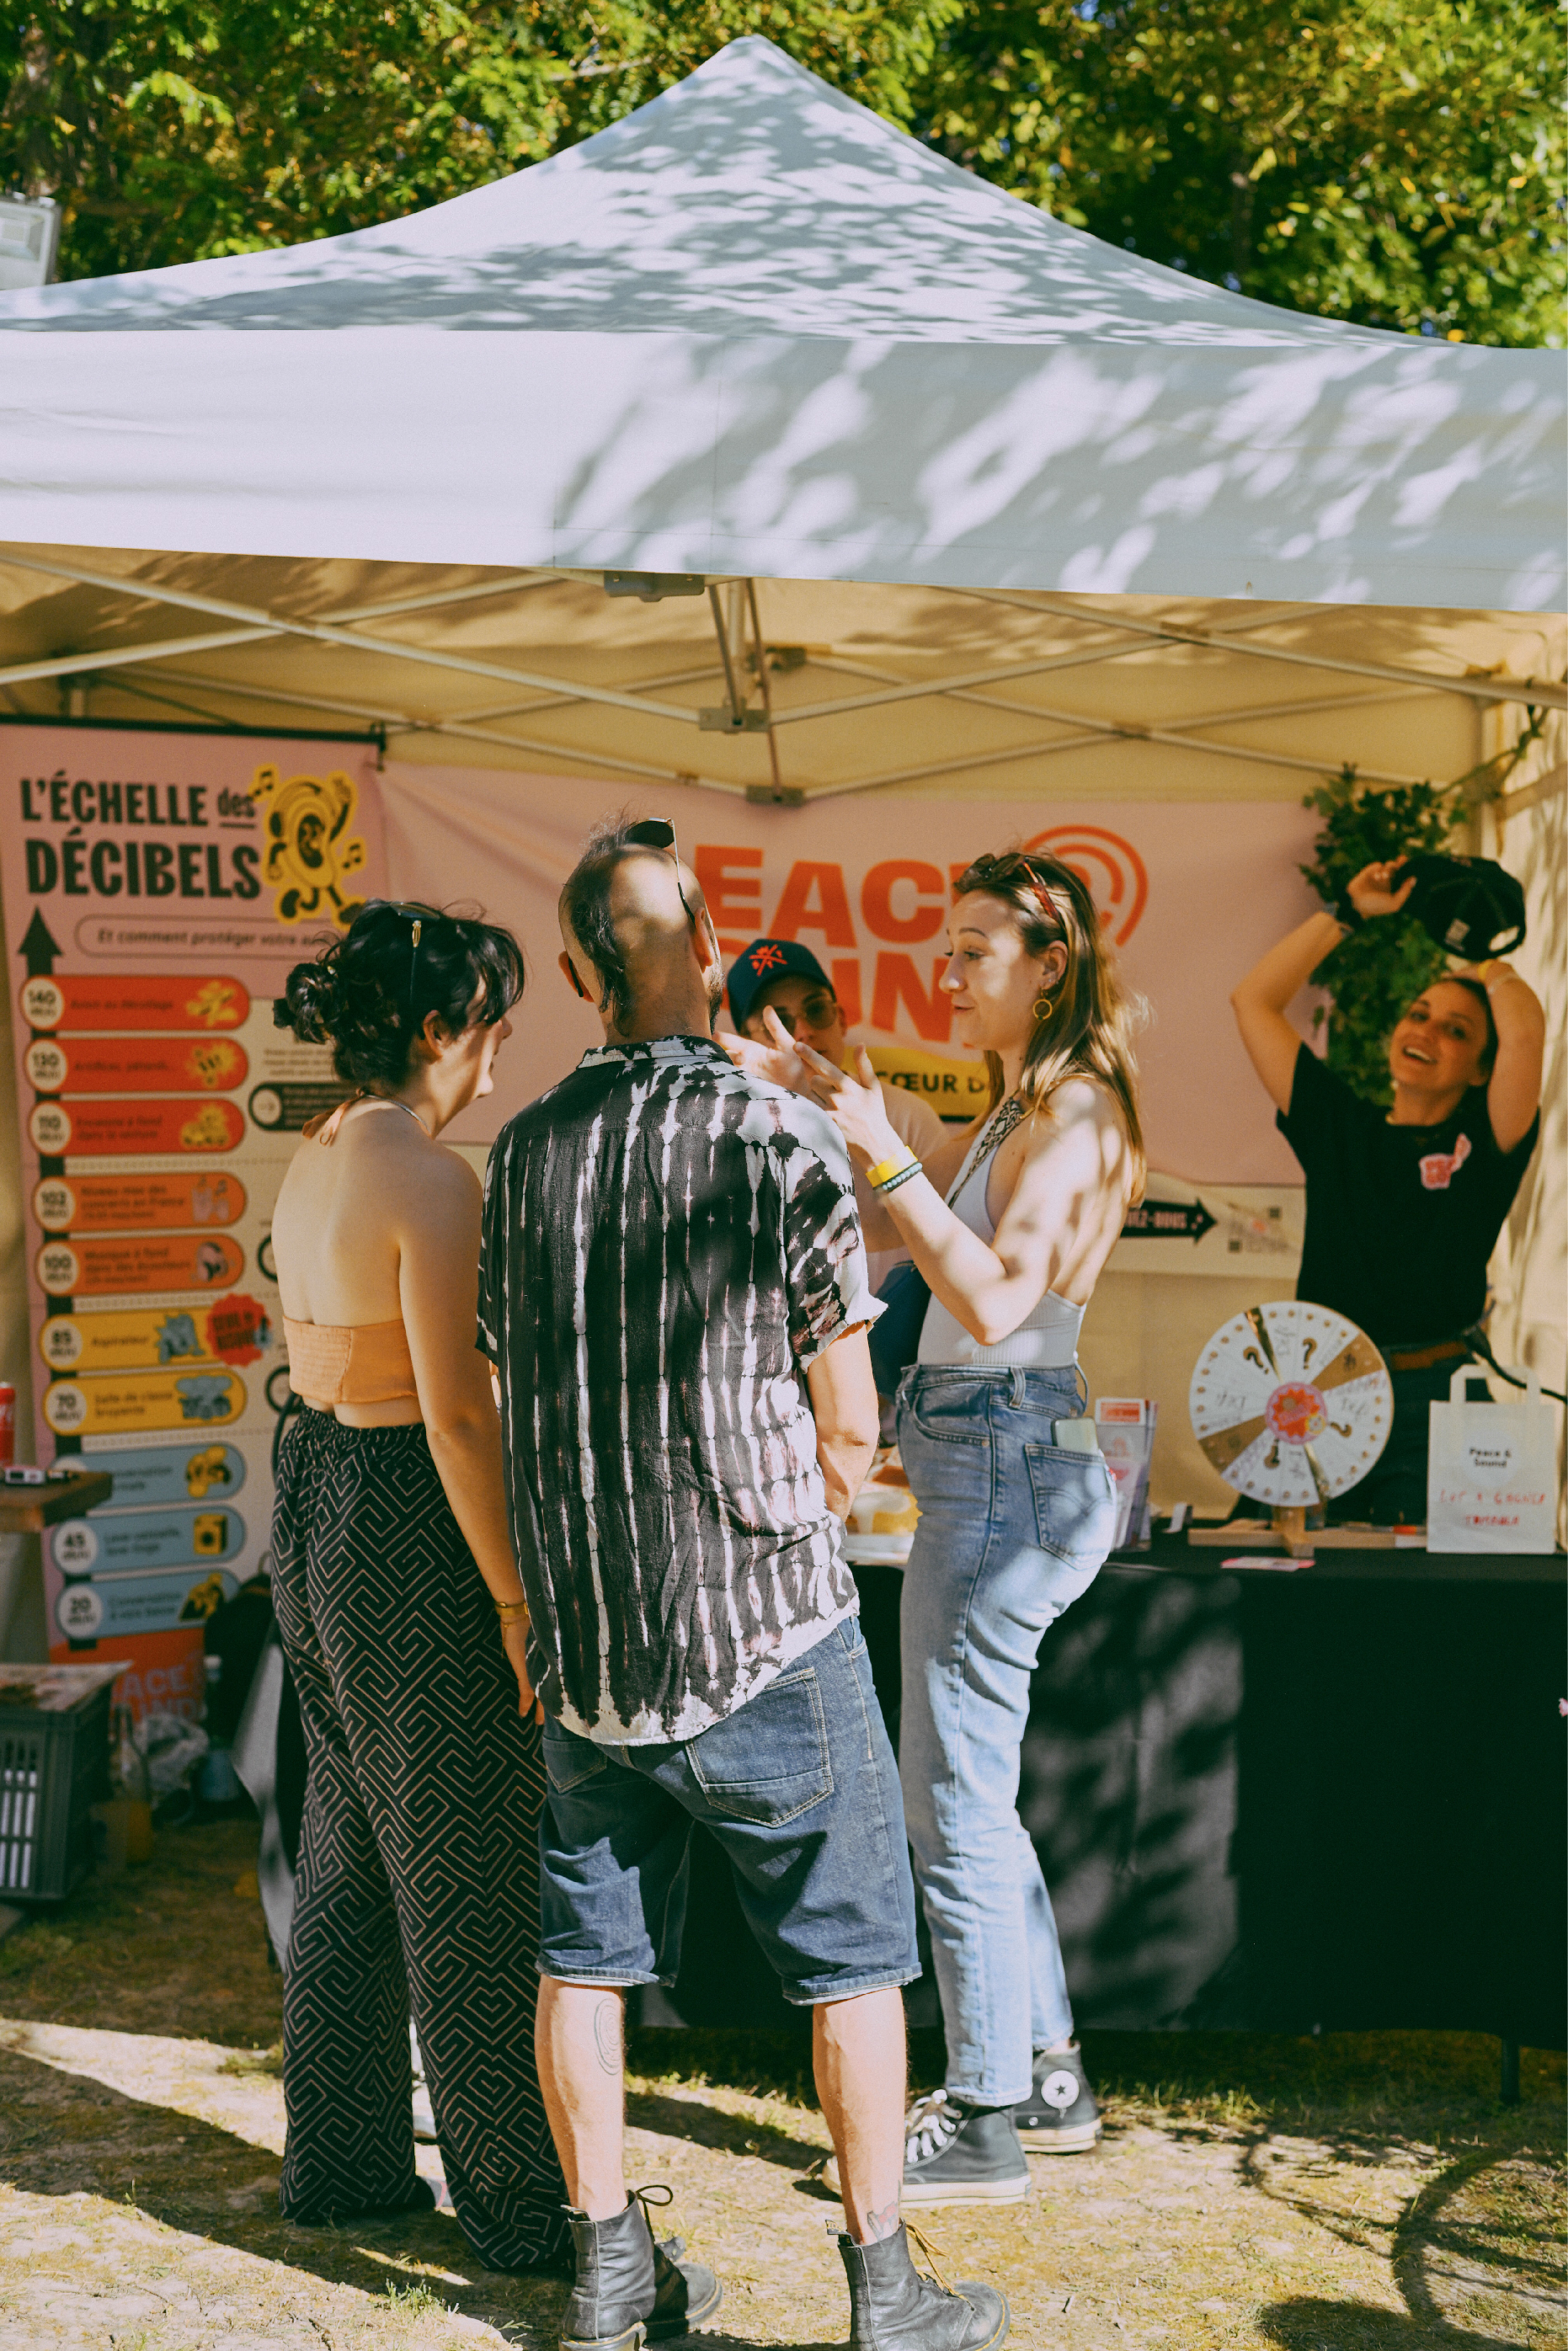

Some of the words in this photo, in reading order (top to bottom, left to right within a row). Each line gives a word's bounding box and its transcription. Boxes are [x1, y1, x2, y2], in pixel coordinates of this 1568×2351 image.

[21, 770, 209, 827] L'ÉCHELLE
[217, 786, 257, 818] des
[25, 826, 261, 900] DÉCIBELS
[694, 845, 967, 949] EAC
[116, 930, 189, 944] comment
[27, 989, 57, 1005] 140
[32, 1053, 60, 1068] 130
[51, 1330, 72, 1346] 85
[56, 1394, 76, 1410] 70
[1469, 1446, 1501, 1457] Peace
[64, 1533, 87, 1547] 45
[112, 1664, 189, 1698] ACE
